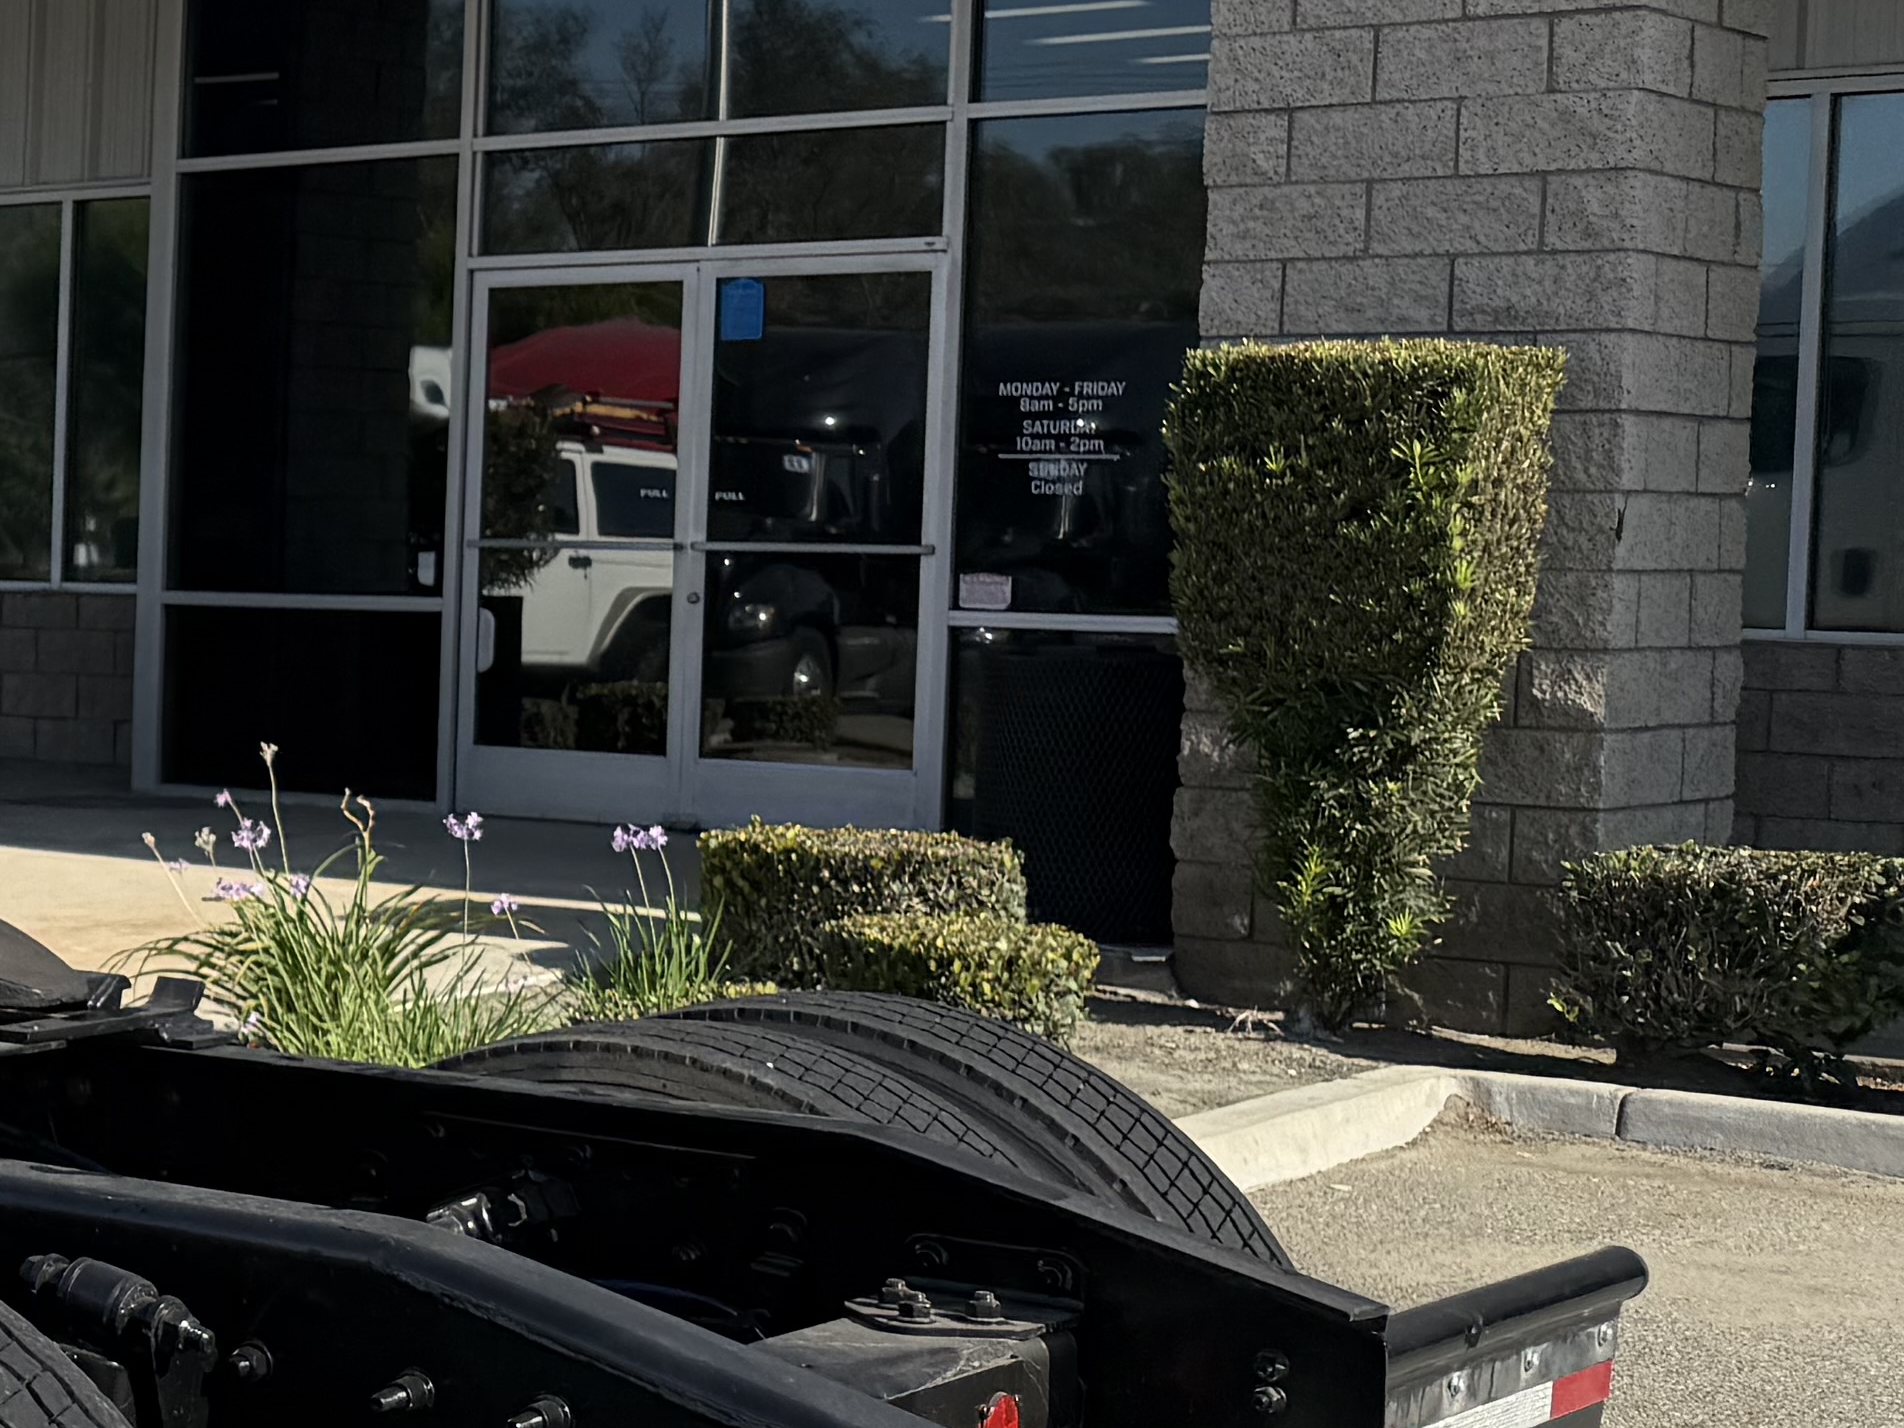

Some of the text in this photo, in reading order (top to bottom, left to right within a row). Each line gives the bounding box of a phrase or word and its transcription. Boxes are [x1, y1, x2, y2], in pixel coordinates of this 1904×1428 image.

[998, 381, 1060, 396] MONDAY
[1074, 381, 1126, 396] FRIDAY
[1020, 397, 1053, 412] 8am
[1068, 397, 1103, 413] 5pm
[1016, 436, 1055, 451] 10am
[1069, 436, 1105, 453] 2pm
[1031, 480, 1084, 495] Closed
